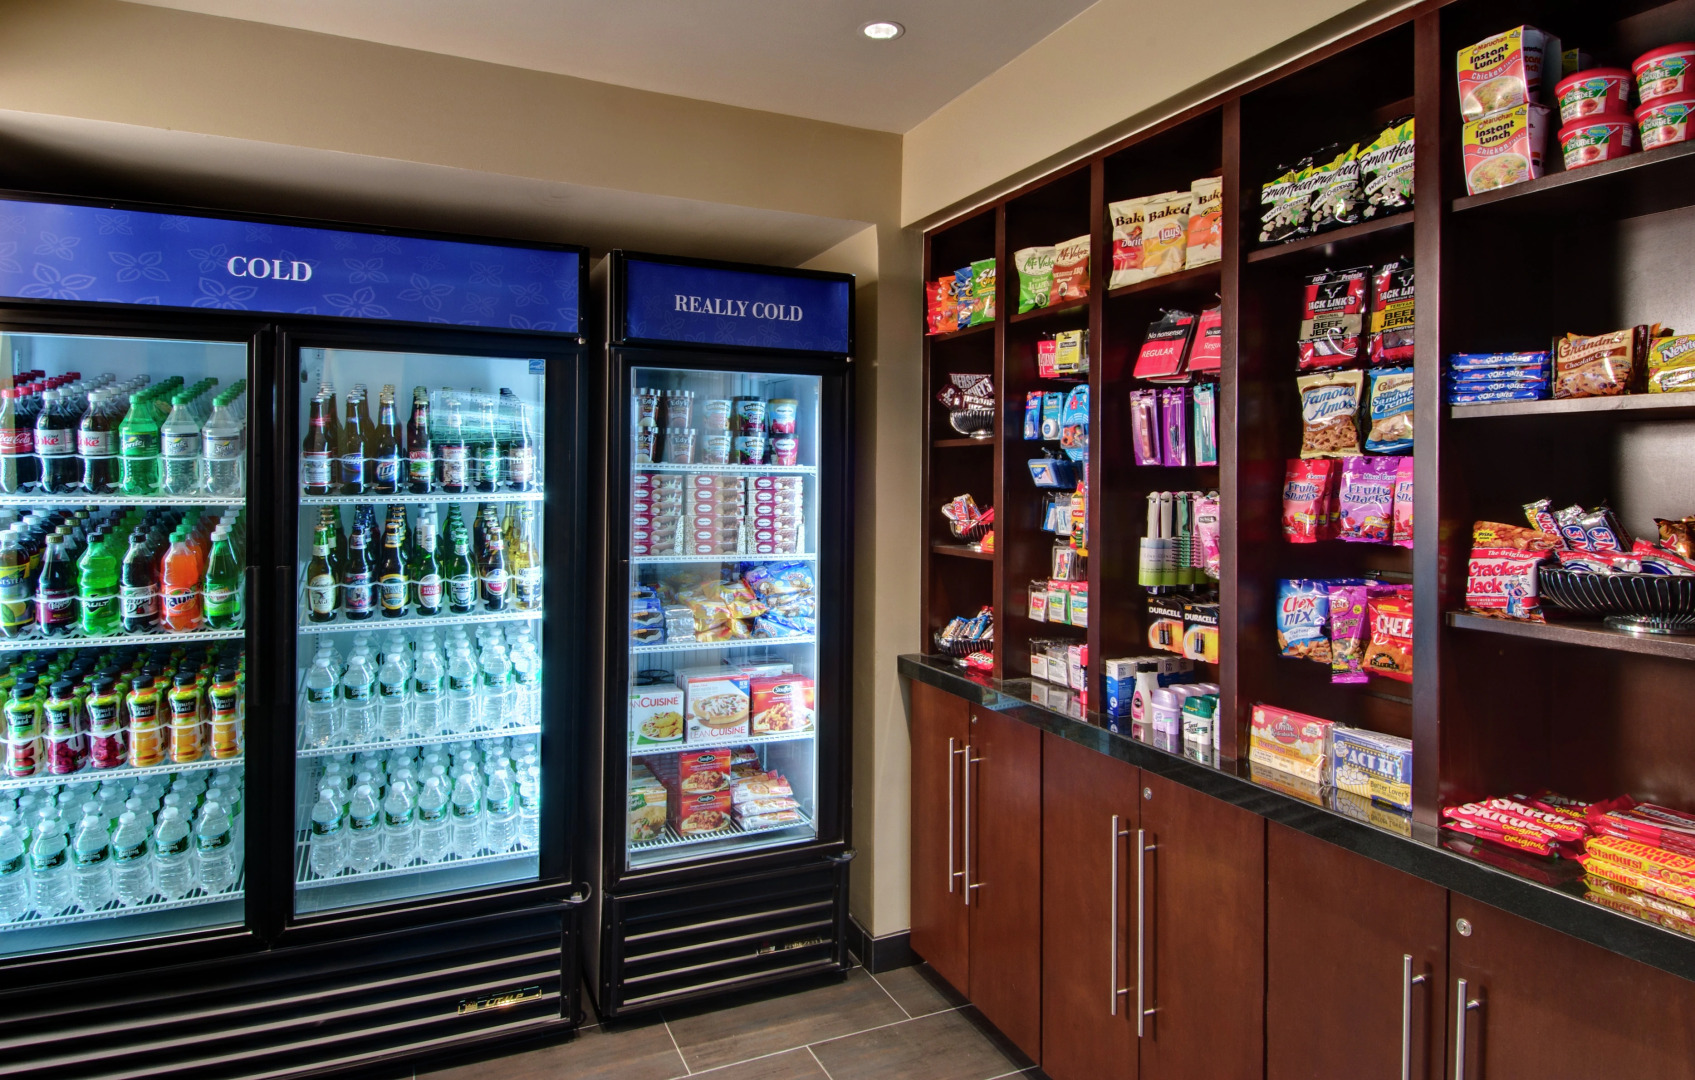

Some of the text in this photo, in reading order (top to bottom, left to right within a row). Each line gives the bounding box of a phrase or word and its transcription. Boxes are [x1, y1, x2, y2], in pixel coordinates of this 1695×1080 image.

[1469, 43, 1509, 64] Instant
[1474, 53, 1505, 70] Lunch
[1471, 66, 1503, 80] Chicken
[1475, 120, 1515, 138] Instant
[1480, 130, 1511, 146] Lunch
[1477, 142, 1509, 156] Chicken
[1148, 202, 1192, 223] Baked
[226, 255, 313, 282] COLD
[674, 294, 804, 322] REALLY COLD
[1327, 294, 1356, 308] LINK'S
[1313, 319, 1343, 330] BEEF
[1147, 328, 1184, 340] No nonsense
[1141, 347, 1174, 358] REGULAR
[1564, 355, 1595, 370] Chocolate
[1303, 385, 1355, 409] Famous
[1308, 396, 1356, 421] Amos
[1347, 483, 1391, 495] Fruity
[1343, 493, 1391, 503] Snacks
[1500, 550, 1533, 559] Original
[1468, 560, 1533, 577] Cracker
[1465, 577, 1504, 594] Jack
[1282, 595, 1317, 611] Chex
[1148, 606, 1182, 618] DURACELL
[1184, 613, 1217, 624] DURACELL
[1284, 609, 1313, 626] mix
[1376, 615, 1413, 638] CHEE
[640, 696, 680, 708] CUISINE
[710, 725, 746, 737] CUISINE
[1347, 749, 1395, 775] ACT II
[1370, 780, 1409, 798] Butter Lover's
[1458, 802, 1560, 837] Skittles
[1589, 847, 1643, 869] Starburst
[1588, 864, 1639, 886] Starburst
